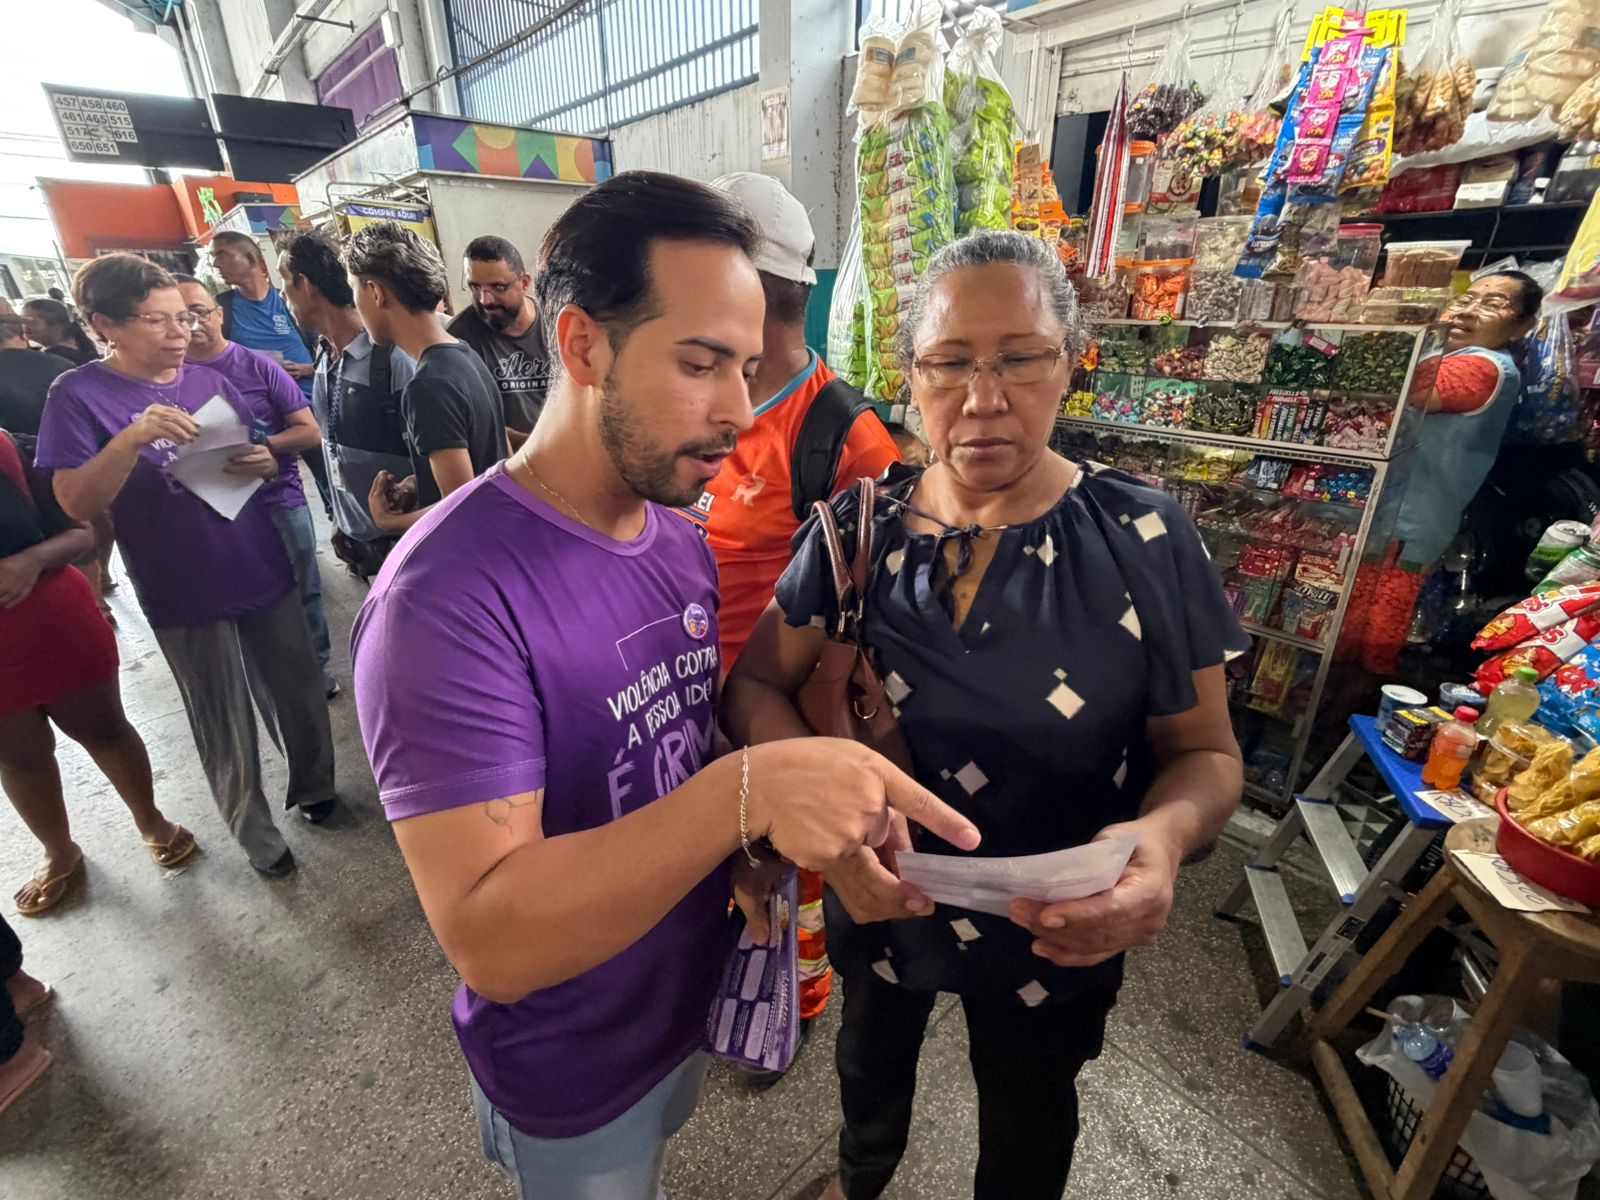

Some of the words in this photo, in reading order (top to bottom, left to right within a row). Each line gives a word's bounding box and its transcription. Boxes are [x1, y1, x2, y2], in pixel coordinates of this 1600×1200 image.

[55, 95, 77, 107] 457
[81, 98, 103, 110] 458
[105, 100, 127, 112] 460
[110, 116, 131, 126] 515
[96, 142, 117, 152] 651
[362, 207, 396, 218] COMPRE
[607, 661, 671, 722] VIOLÊNCIA
[627, 722, 643, 750] A
[645, 691, 682, 739] PESSOA
